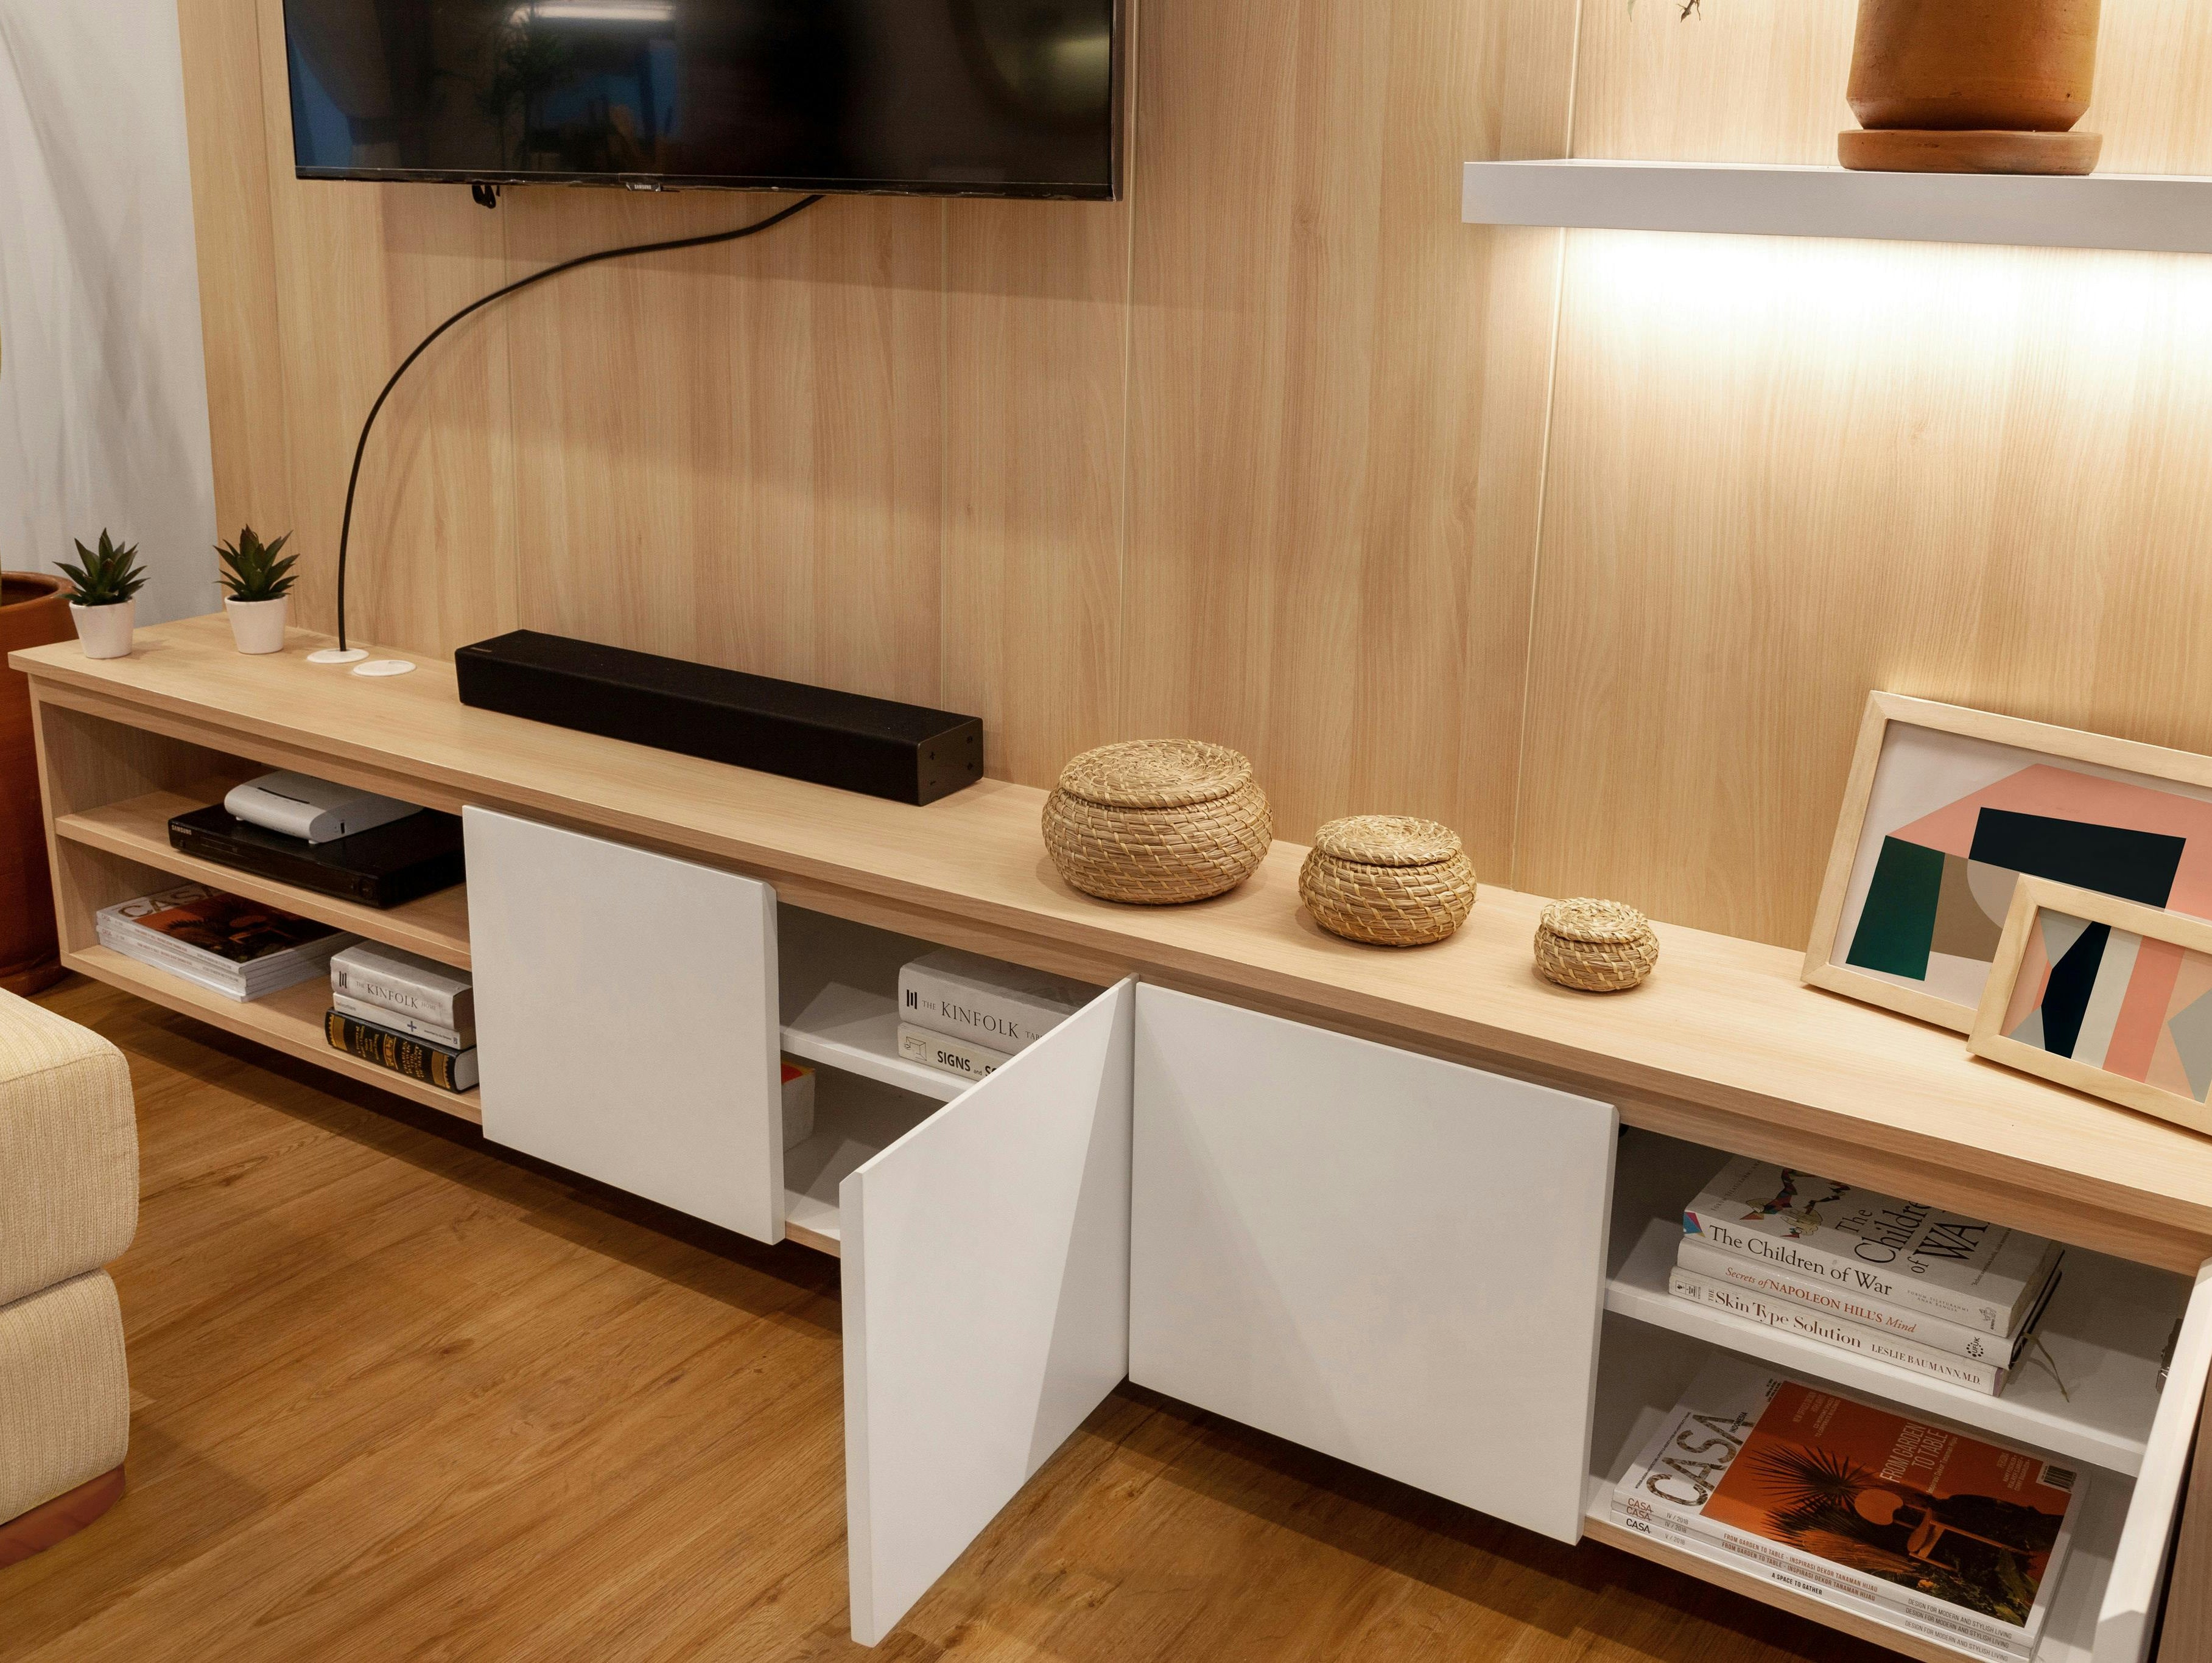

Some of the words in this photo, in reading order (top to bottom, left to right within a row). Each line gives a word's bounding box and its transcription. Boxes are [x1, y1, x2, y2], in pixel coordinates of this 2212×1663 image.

[171, 824, 192, 836] SAMSUNG
[367, 984, 418, 1009] KINFOLK
[922, 1000, 936, 1010] THE
[941, 1001, 1019, 1038] KINFOLK
[937, 1051, 971, 1072] SIGNS
[1835, 1209, 1873, 1233] The
[1854, 1200, 1932, 1263] Childre
[1912, 1222, 1991, 1259] WA
[1709, 1225, 1742, 1248] The
[1747, 1238, 1825, 1275] Children
[1830, 1267, 1852, 1281] of
[1854, 1270, 1892, 1295] War
[1907, 1256, 1929, 1273] of
[1725, 1267, 1755, 1284] Secrets
[1758, 1279, 1770, 1289] of
[1769, 1280, 1840, 1309] NAPOLEON
[1844, 1303, 1883, 1323] HILL'S
[1886, 1317, 1917, 1333] Mind
[1715, 1291, 1749, 1313] Skin
[1752, 1301, 1789, 1325] Type
[1793, 1316, 1861, 1348] Solution
[1871, 1344, 1906, 1362] LESLIE
[1971, 1337, 1980, 1353] UFUK
[1729, 1412, 1748, 1434] INDONESIA
[1890, 1423, 1927, 1460] GARDEN
[1917, 1429, 1949, 1459] TABLE
[1646, 1414, 1755, 1507] CASA
[1879, 1452, 1909, 1483] FROM
[1911, 1454, 1936, 1470] TO
[1626, 1507, 1652, 1522] CASA
[1674, 1524, 1687, 1534] 2018
[1627, 1498, 1654, 1513] CASA
[1676, 1516, 1688, 1525] 2018
[1626, 1518, 1652, 1533] CASA
[1673, 1536, 1685, 1546] 2018
[1722, 1542, 1736, 1551] FROM
[1737, 1546, 1757, 1559] GARDEN
[1766, 1557, 1783, 1568] TABLE
[1788, 1565, 1814, 1579] INSPIRASI
[1814, 1574, 1832, 1586] DEKOR
[1833, 1581, 1858, 1595] TANAMAN
[1859, 1591, 1875, 1602] HIJAU
[1724, 1533, 1738, 1543] FROM
[1739, 1538, 1759, 1550] GARDEN
[1769, 1549, 1785, 1559] TABLE
[1789, 1556, 1816, 1570] INSPIRASI
[1817, 1566, 1834, 1577] DEKOR
[1836, 1572, 1861, 1586] TANAMAN
[1862, 1581, 1878, 1592] HIJAU
[1777, 1574, 1793, 1585] SPACE
[1802, 1583, 1822, 1595] GATHER
[1906, 1607, 1923, 1620] DESIGN
[1924, 1614, 1934, 1623] FOR
[1936, 1617, 1957, 1631] MODERN
[1957, 1625, 1968, 1634] AND
[1969, 1628, 1992, 1643] STYLISH
[1992, 1637, 2009, 1649] LIVING
[1908, 1598, 1926, 1611] DESIGN
[1927, 1605, 1937, 1613] FOR
[1938, 1608, 1959, 1622] MODERN
[1960, 1616, 1971, 1625] AND
[1972, 1619, 1994, 1634] STYLISH
[1995, 1627, 2012, 1639] LIVING
[1905, 1620, 1923, 1632] DESIGN
[1923, 1626, 1934, 1635] FOR
[1934, 1630, 1956, 1644] MODERN
[1957, 1638, 1968, 1648] AND
[1968, 1642, 1990, 1656] STYLISH
[1991, 1650, 2008, 1662] LIVING
